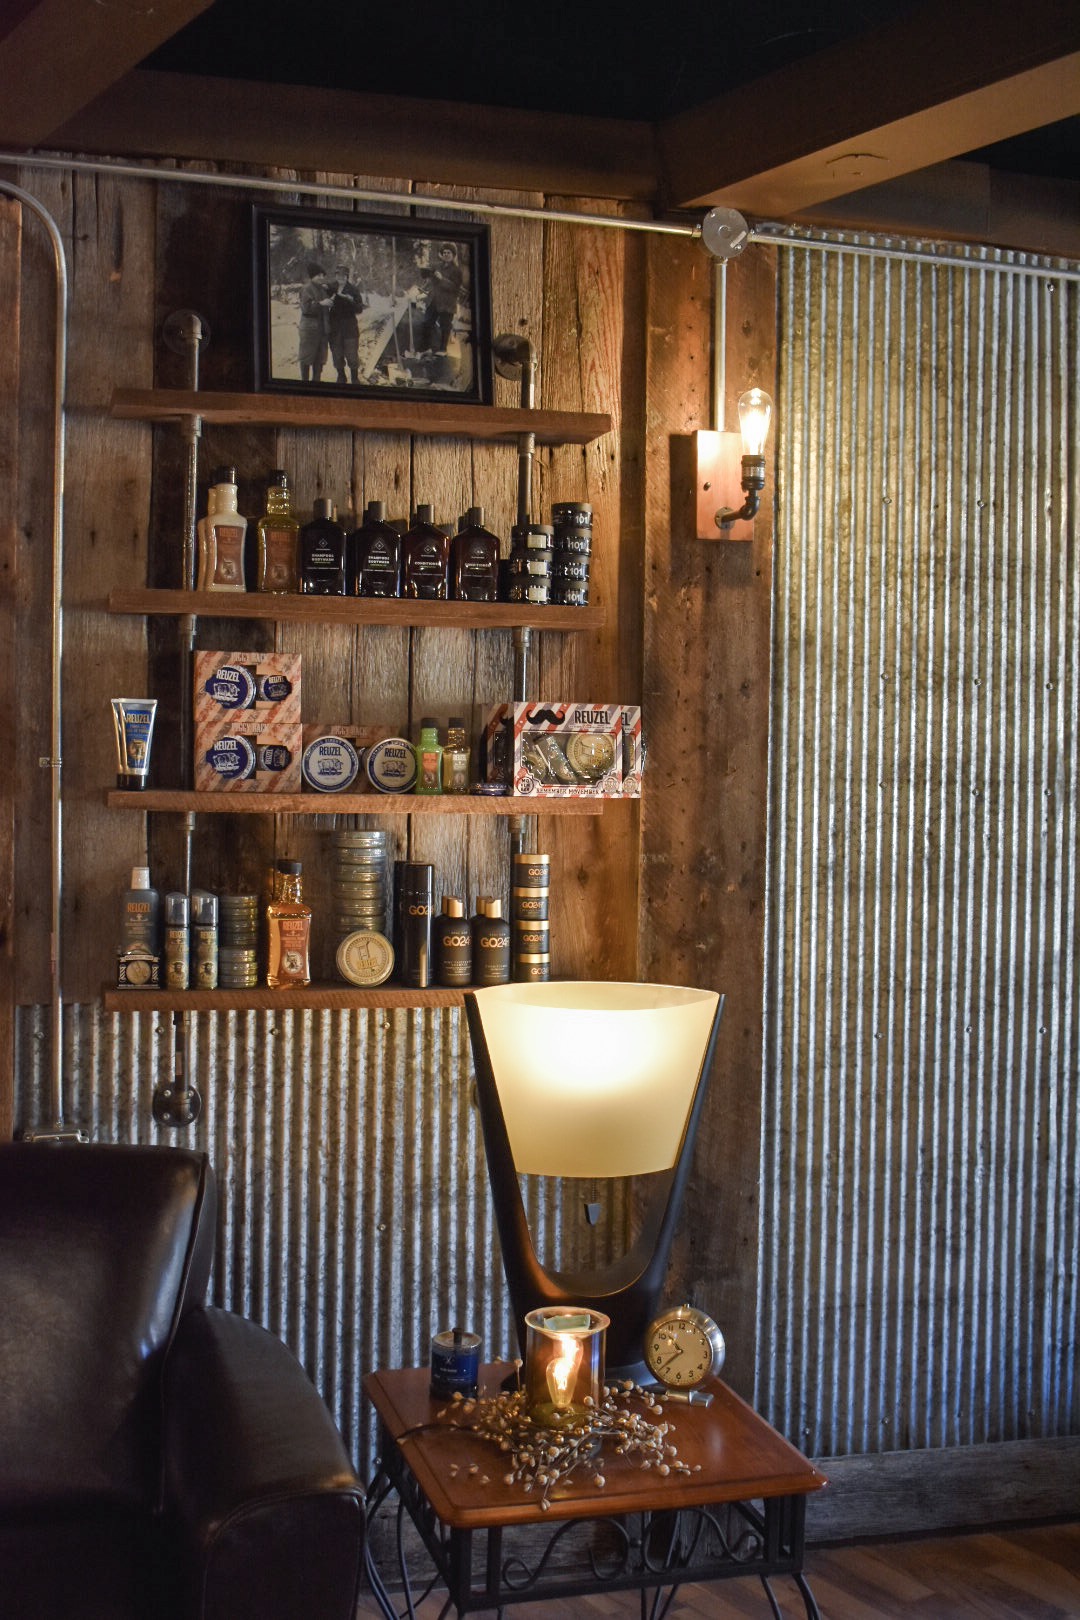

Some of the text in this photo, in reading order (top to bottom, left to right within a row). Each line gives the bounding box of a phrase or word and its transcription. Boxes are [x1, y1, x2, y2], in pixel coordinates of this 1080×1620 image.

[216, 669, 240, 682] REUZEL
[126, 713, 151, 723] REUZEL
[574, 710, 611, 725] REUZEL
[214, 740, 238, 750] REUZEL
[319, 746, 342, 756] REUZEL
[384, 747, 407, 758] REUZEL
[699, 1338, 705, 1346] 2
[654, 1343, 660, 1352] 9
[703, 1350, 708, 1359] 3
[656, 1356, 662, 1365] 8
[676, 1371, 682, 1380] 6
[688, 1370, 694, 1378] 5
